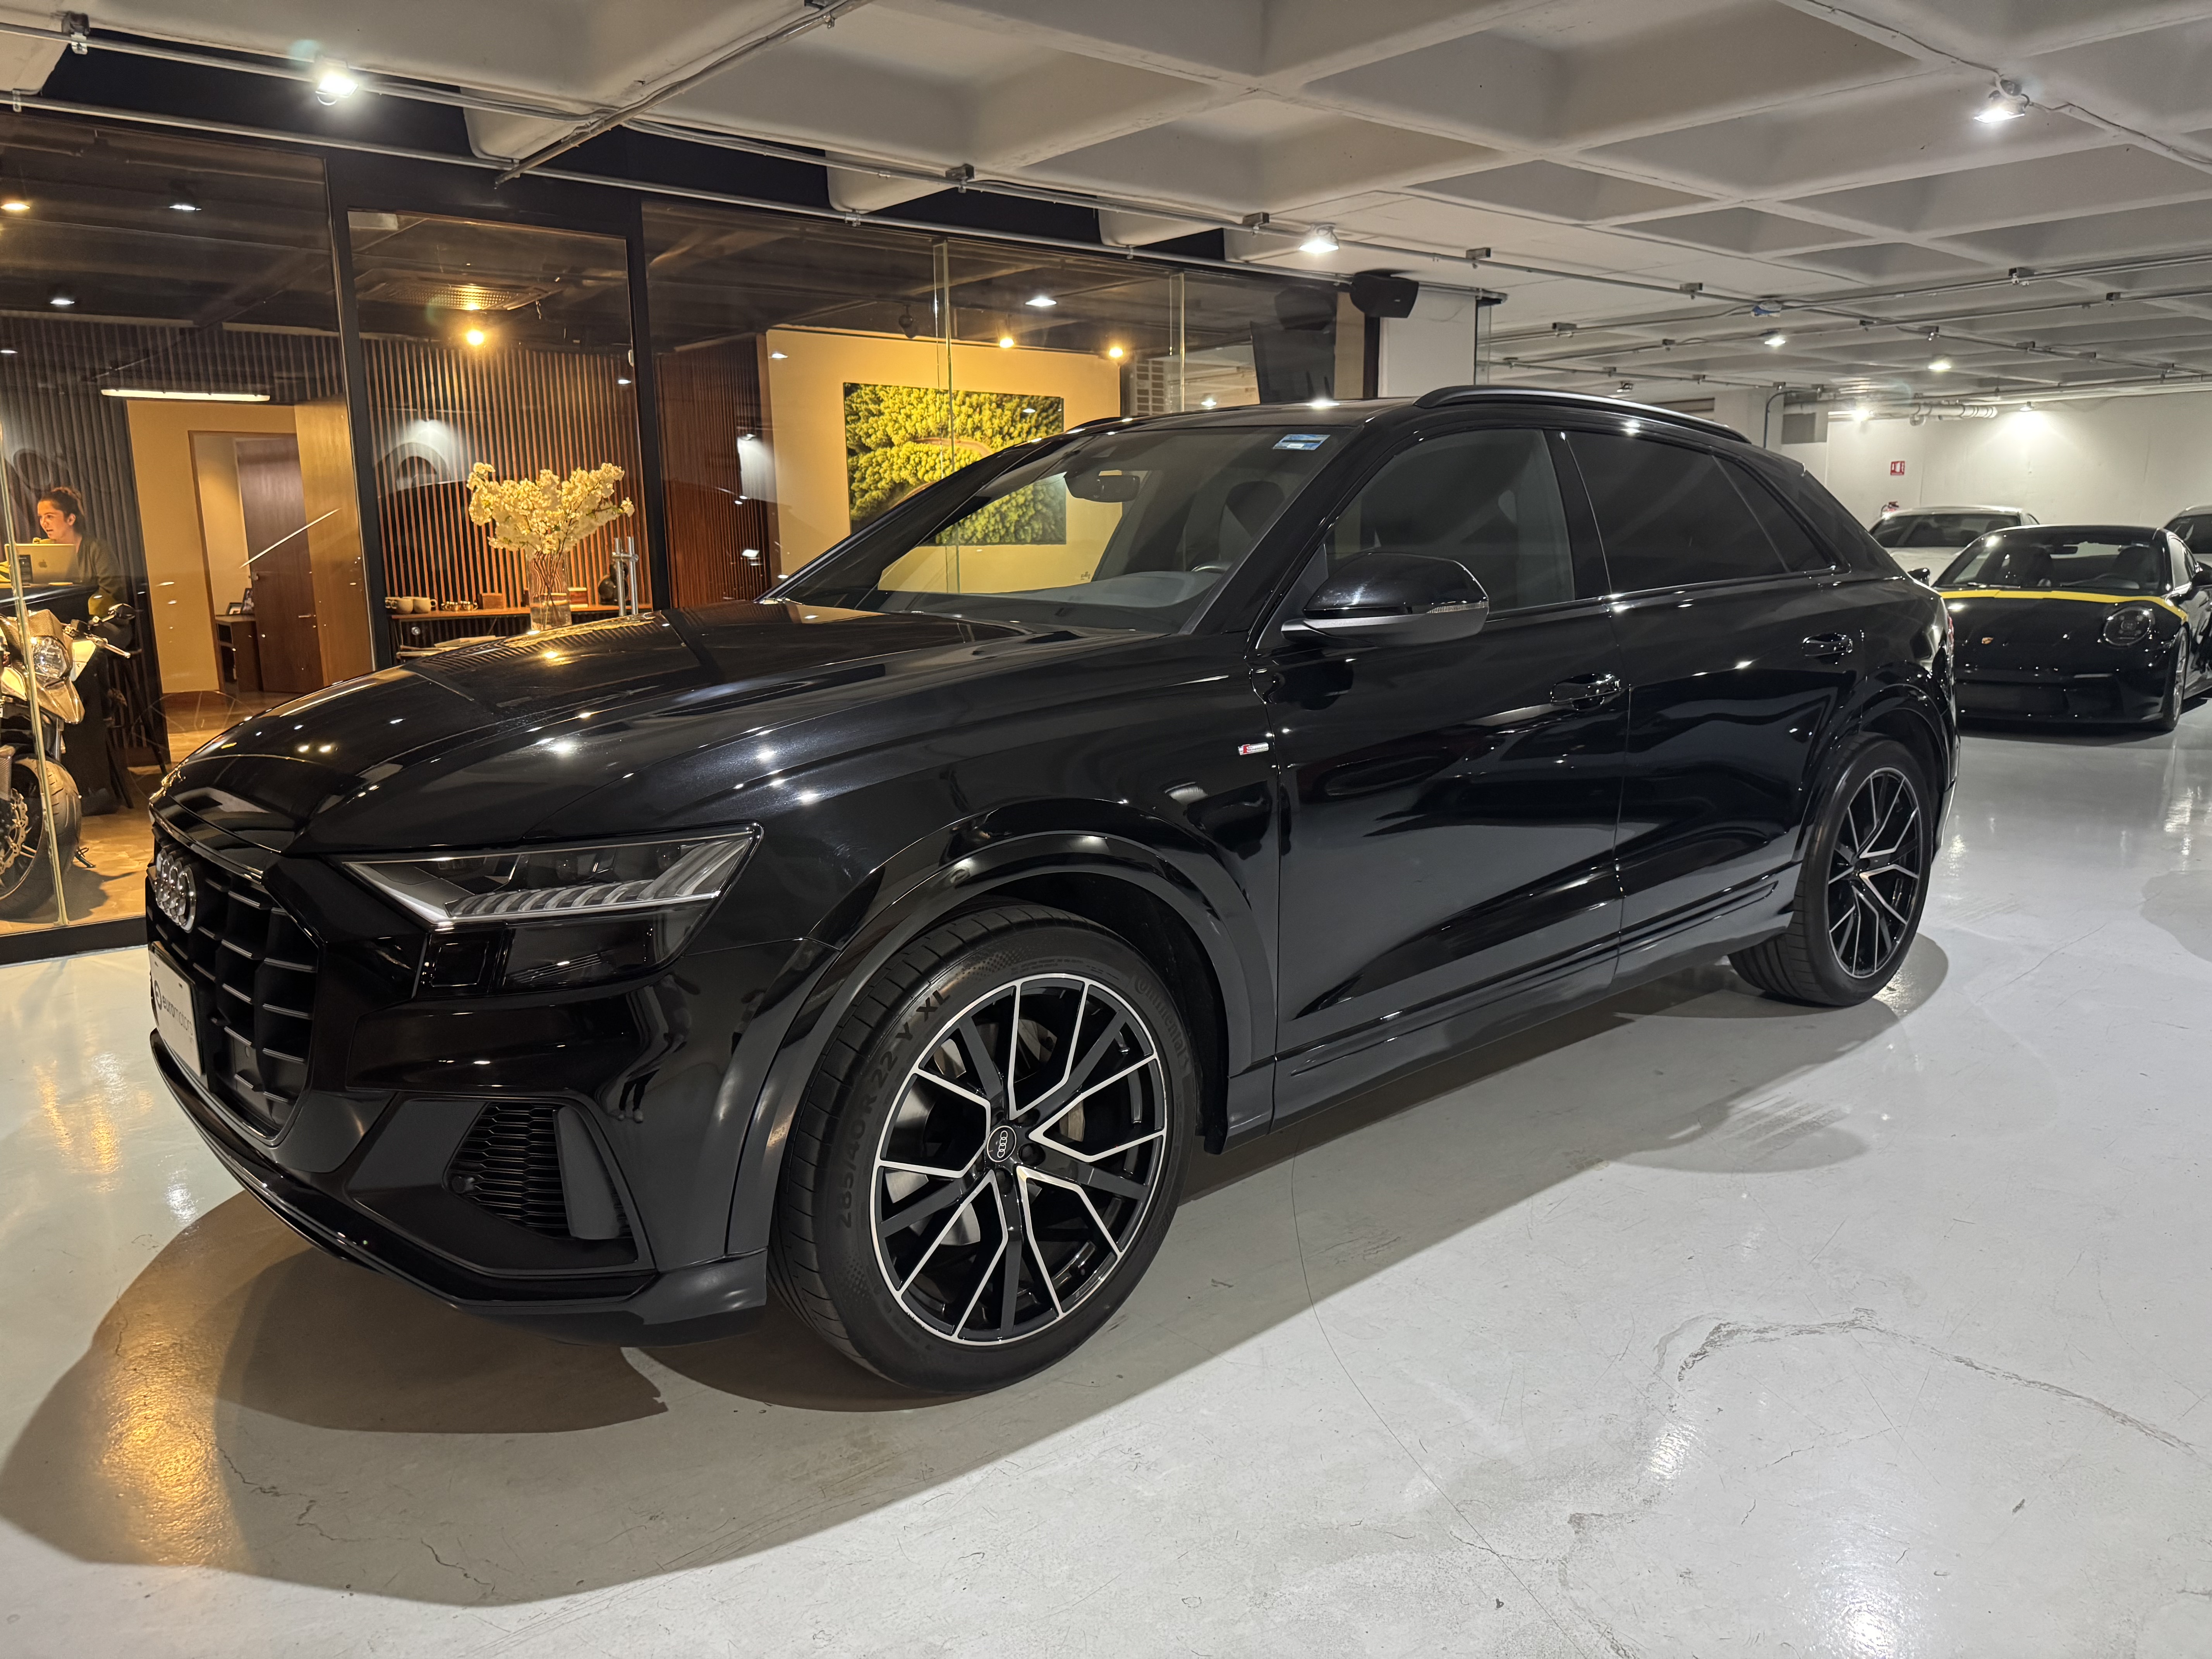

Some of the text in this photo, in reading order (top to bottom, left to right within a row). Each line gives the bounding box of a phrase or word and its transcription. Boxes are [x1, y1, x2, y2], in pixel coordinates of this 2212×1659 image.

[870, 1051, 898, 1089] 22
[895, 1022, 914, 1041] Y
[916, 990, 951, 1022] XL
